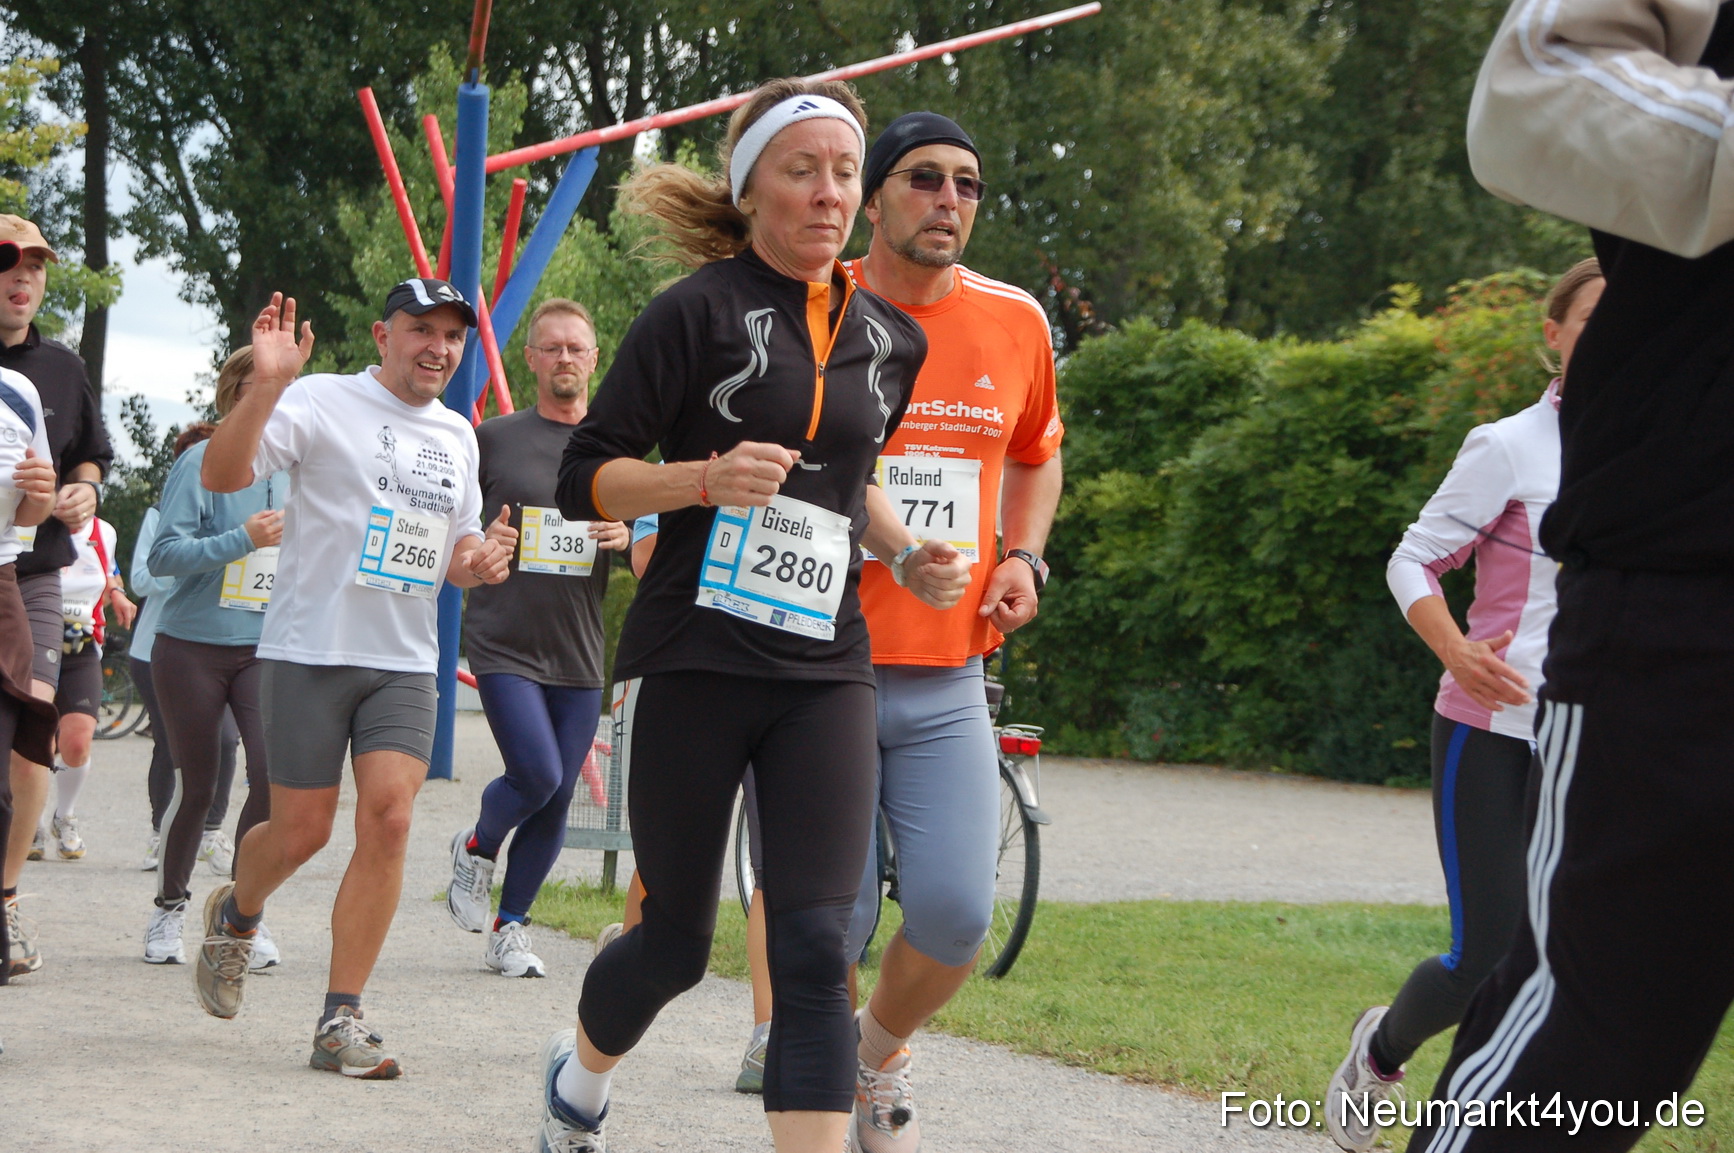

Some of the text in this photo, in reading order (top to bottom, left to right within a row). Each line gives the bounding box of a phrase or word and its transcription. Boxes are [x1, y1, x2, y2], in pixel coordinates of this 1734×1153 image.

[898, 420, 1003, 438] rnberger Stadtlauf 2007
[904, 443, 923, 451] TSV
[416, 460, 456, 477] 21.09.2008
[889, 466, 942, 487] Roland
[378, 476, 393, 491] 9.
[409, 497, 454, 514] Stadtlauf
[902, 499, 955, 528] 771
[396, 518, 429, 539] Stefan
[544, 514, 564, 528] Rolf
[761, 506, 814, 541] Gisela
[371, 535, 379, 546] D
[550, 535, 584, 554] 338
[720, 531, 731, 548] D
[391, 542, 437, 569] 2566
[751, 544, 834, 594] 2880
[253, 572, 275, 590] 23
